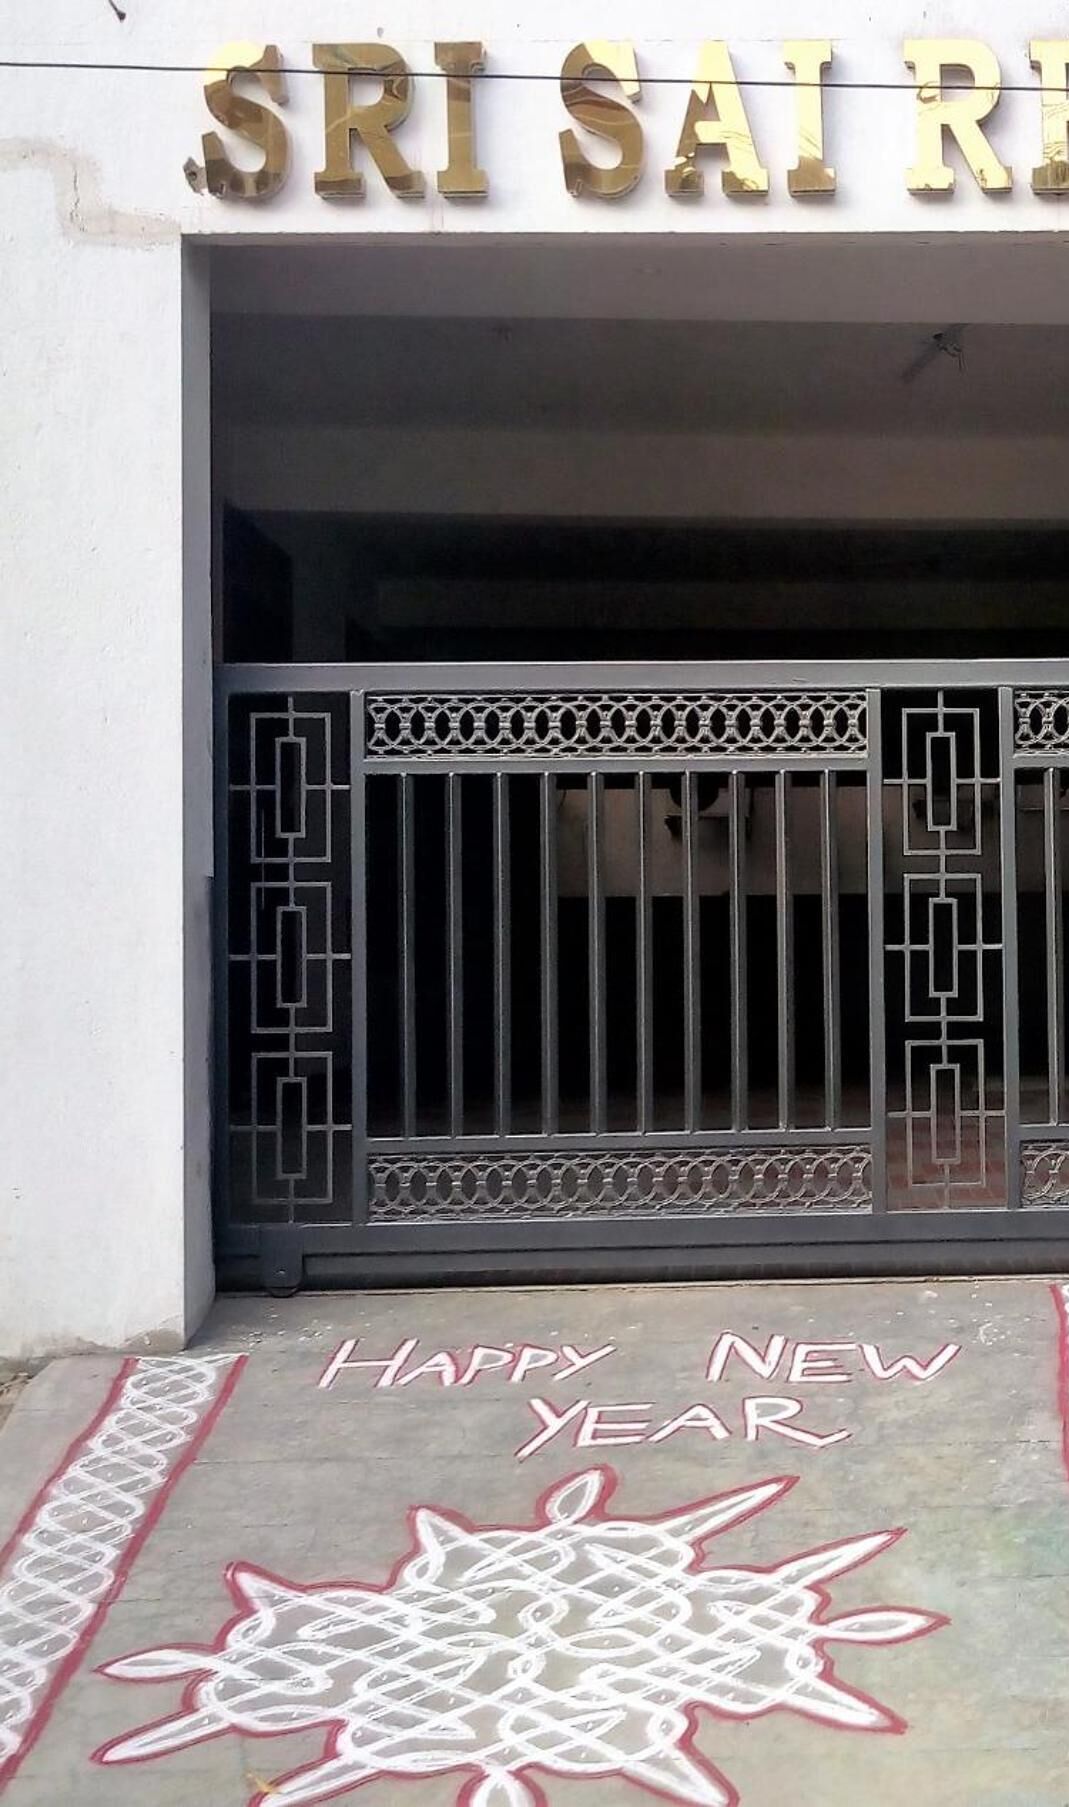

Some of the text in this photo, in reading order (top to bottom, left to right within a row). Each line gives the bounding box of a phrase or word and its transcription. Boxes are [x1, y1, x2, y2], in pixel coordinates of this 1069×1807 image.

[201, 41, 488, 200] SRI
[558, 40, 835, 200] SAI
[316, 1329, 962, 1389] HAPPY NEW
[514, 1396, 854, 1463] YEAR
